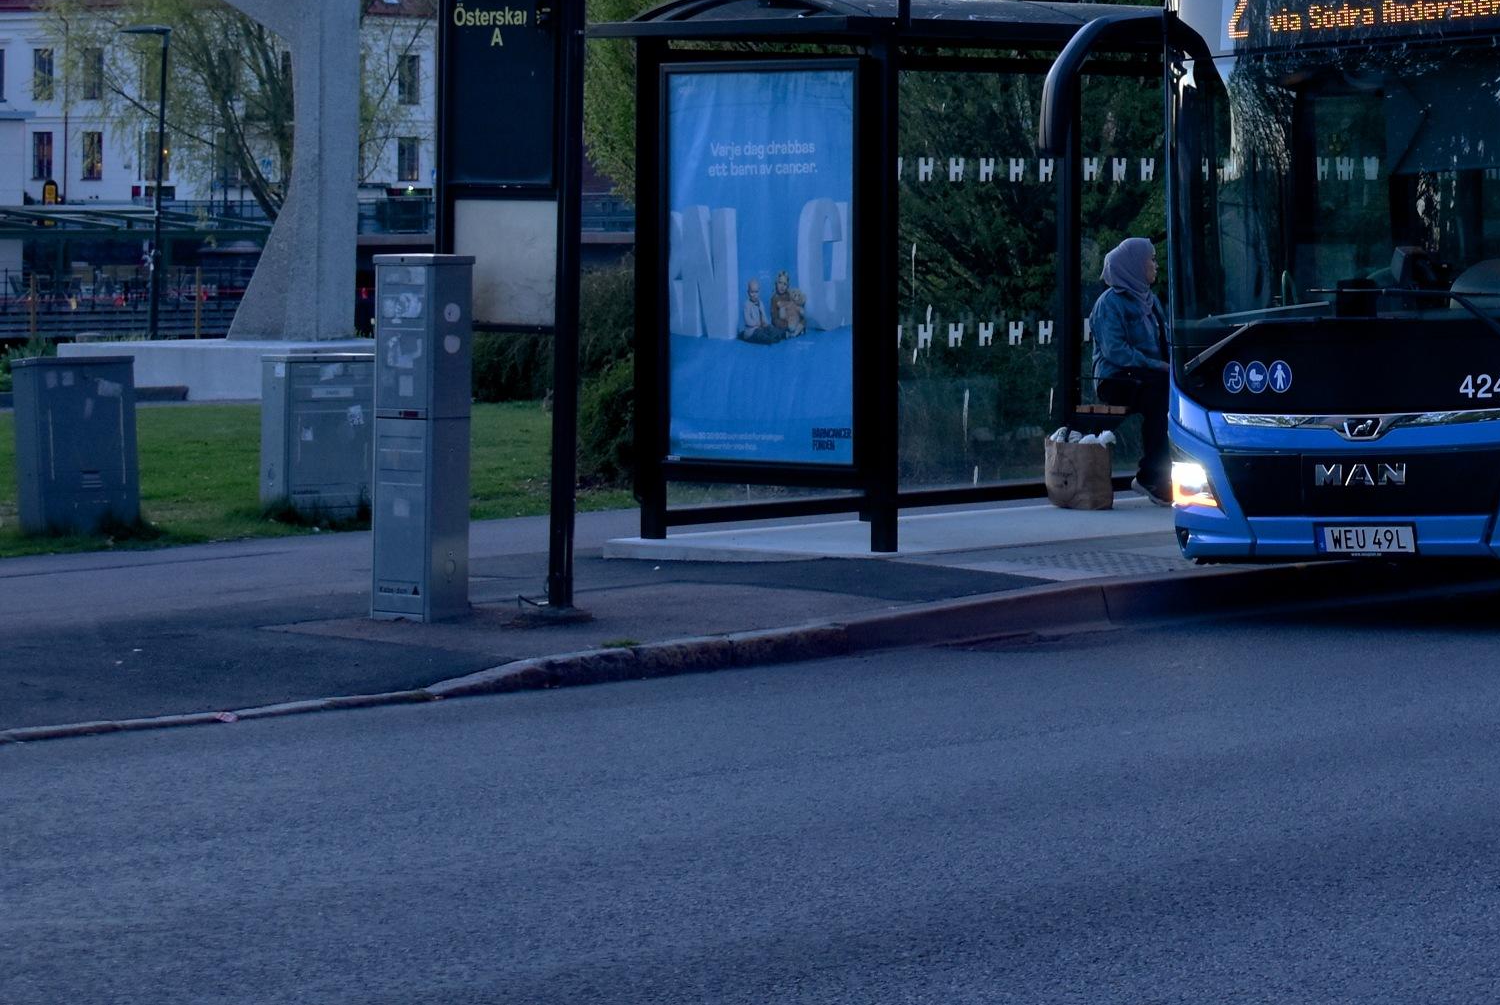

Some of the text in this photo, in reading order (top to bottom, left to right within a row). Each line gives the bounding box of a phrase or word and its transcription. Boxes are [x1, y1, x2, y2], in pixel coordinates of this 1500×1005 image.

[1269, 8, 1301, 33] via
[1309, 2, 1375, 29] Södra
[491, 27, 503, 46] A
[710, 139, 815, 160] Varje dag drabbas
[708, 161, 818, 177] ett barn av cancer.
[1315, 463, 1406, 486] MAN
[1331, 529, 1407, 550] WEU 49L
